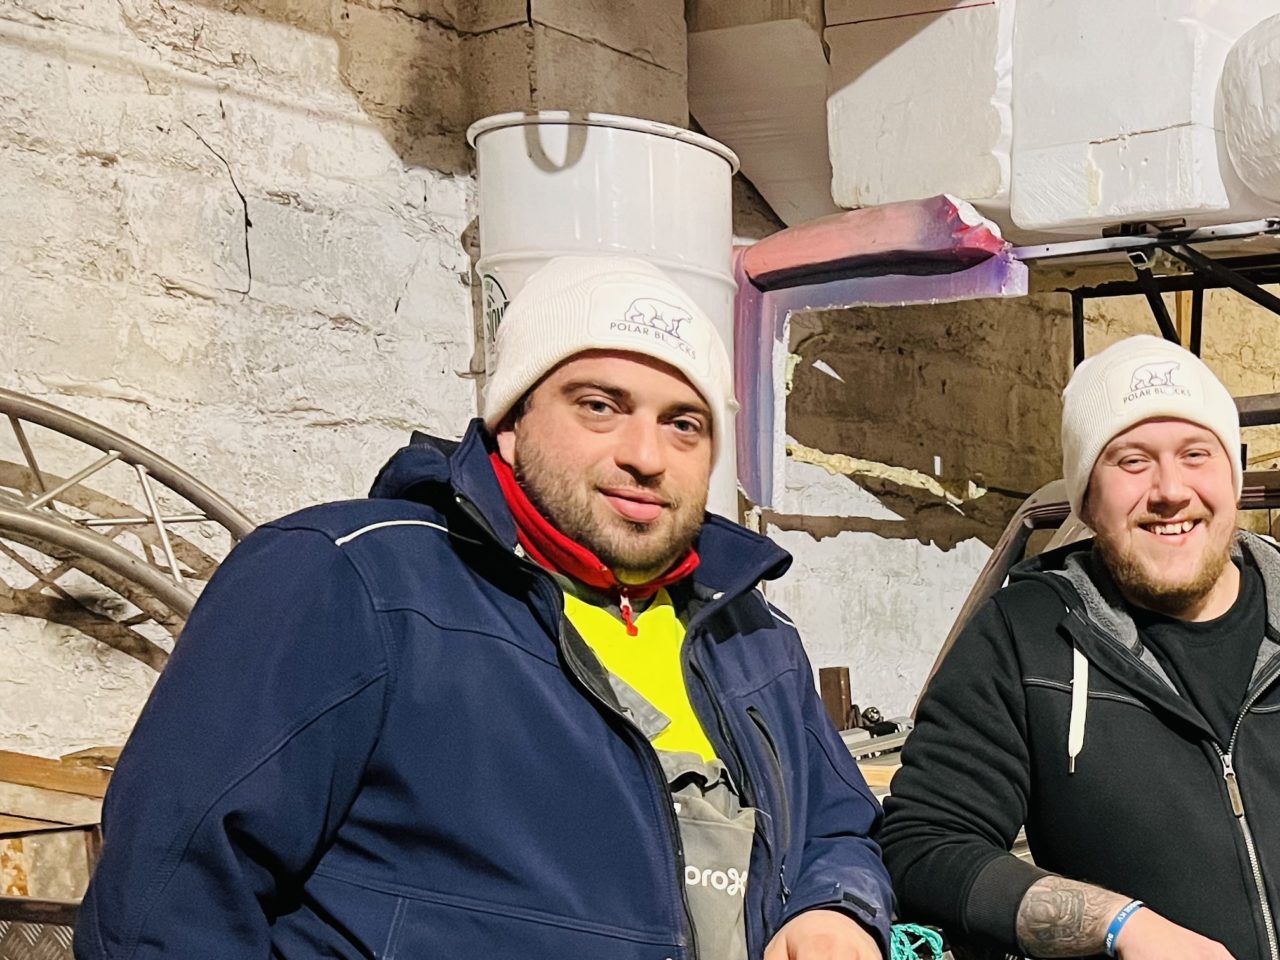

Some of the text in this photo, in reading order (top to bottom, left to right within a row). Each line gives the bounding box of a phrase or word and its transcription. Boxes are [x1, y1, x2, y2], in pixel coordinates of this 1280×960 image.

[609, 321, 697, 360] POLAR BLCKS
[1123, 387, 1191, 405] POLAR BLCKS
